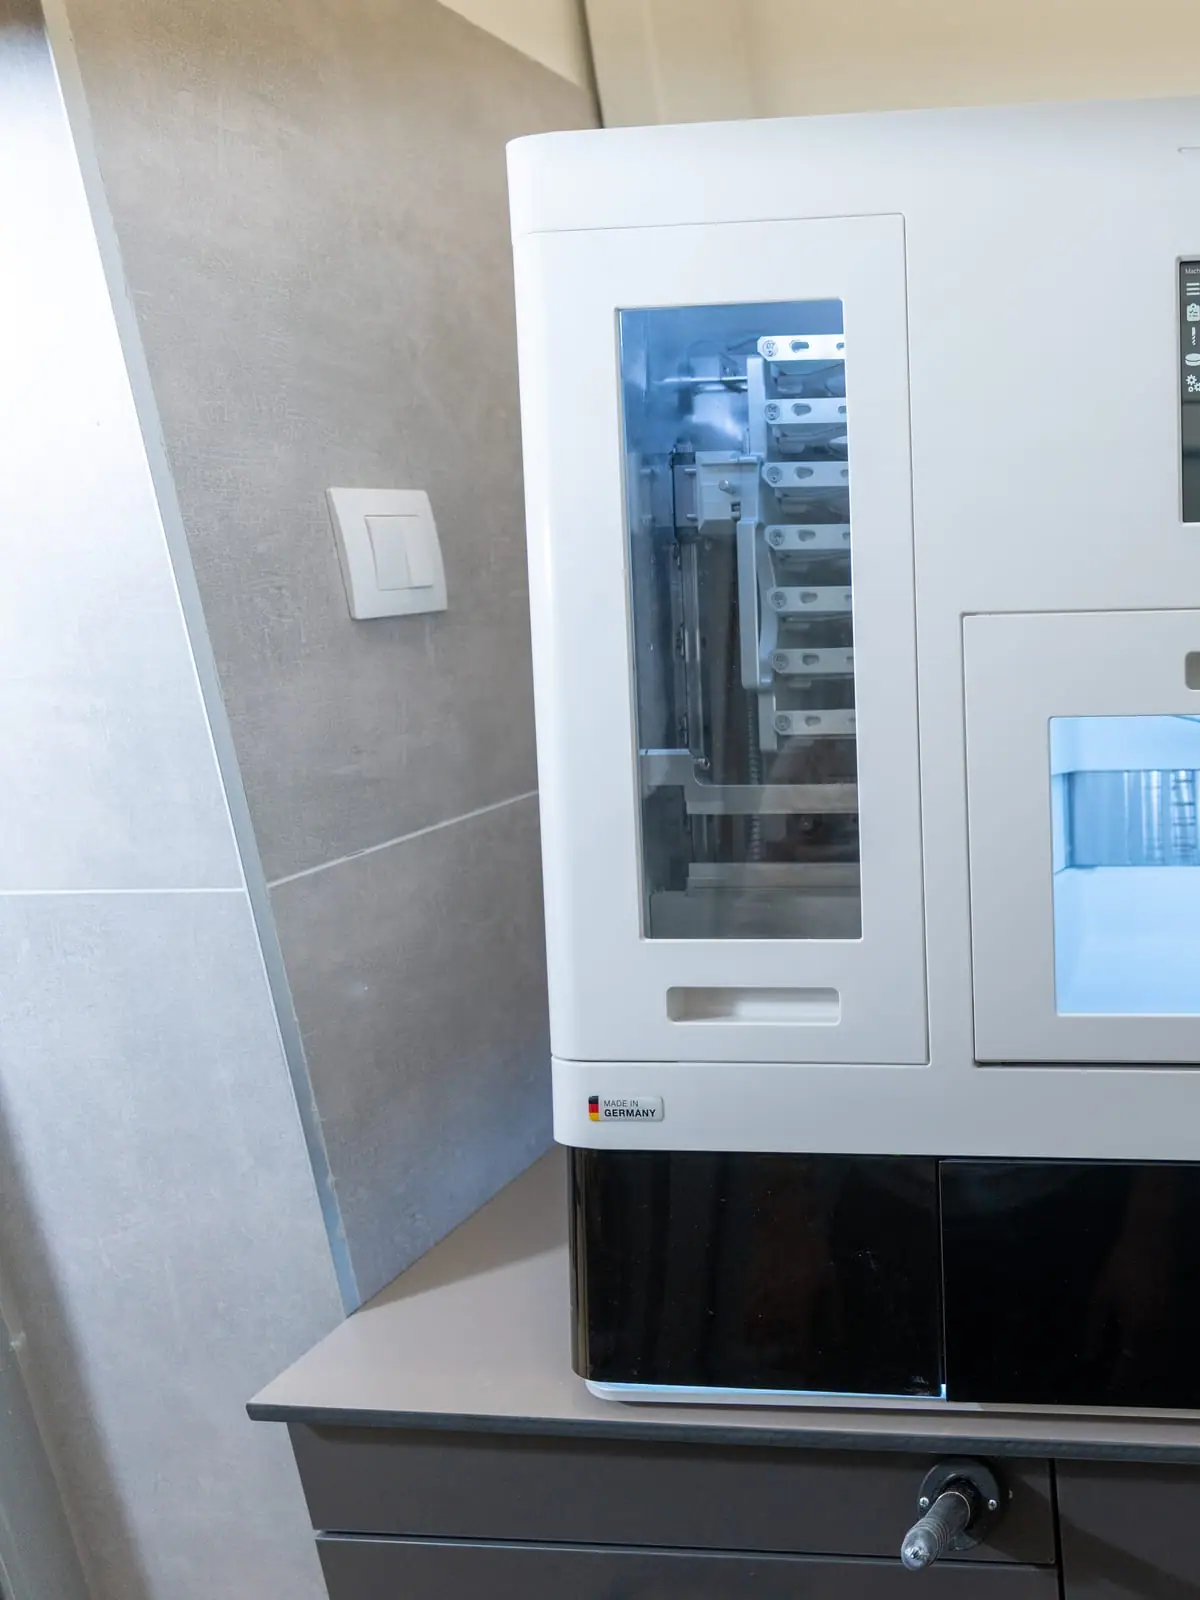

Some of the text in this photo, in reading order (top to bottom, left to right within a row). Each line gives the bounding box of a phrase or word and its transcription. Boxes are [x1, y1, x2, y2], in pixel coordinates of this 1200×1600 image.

[603, 1099, 639, 1108] MADE IN
[604, 1108, 656, 1118] GERMANY
